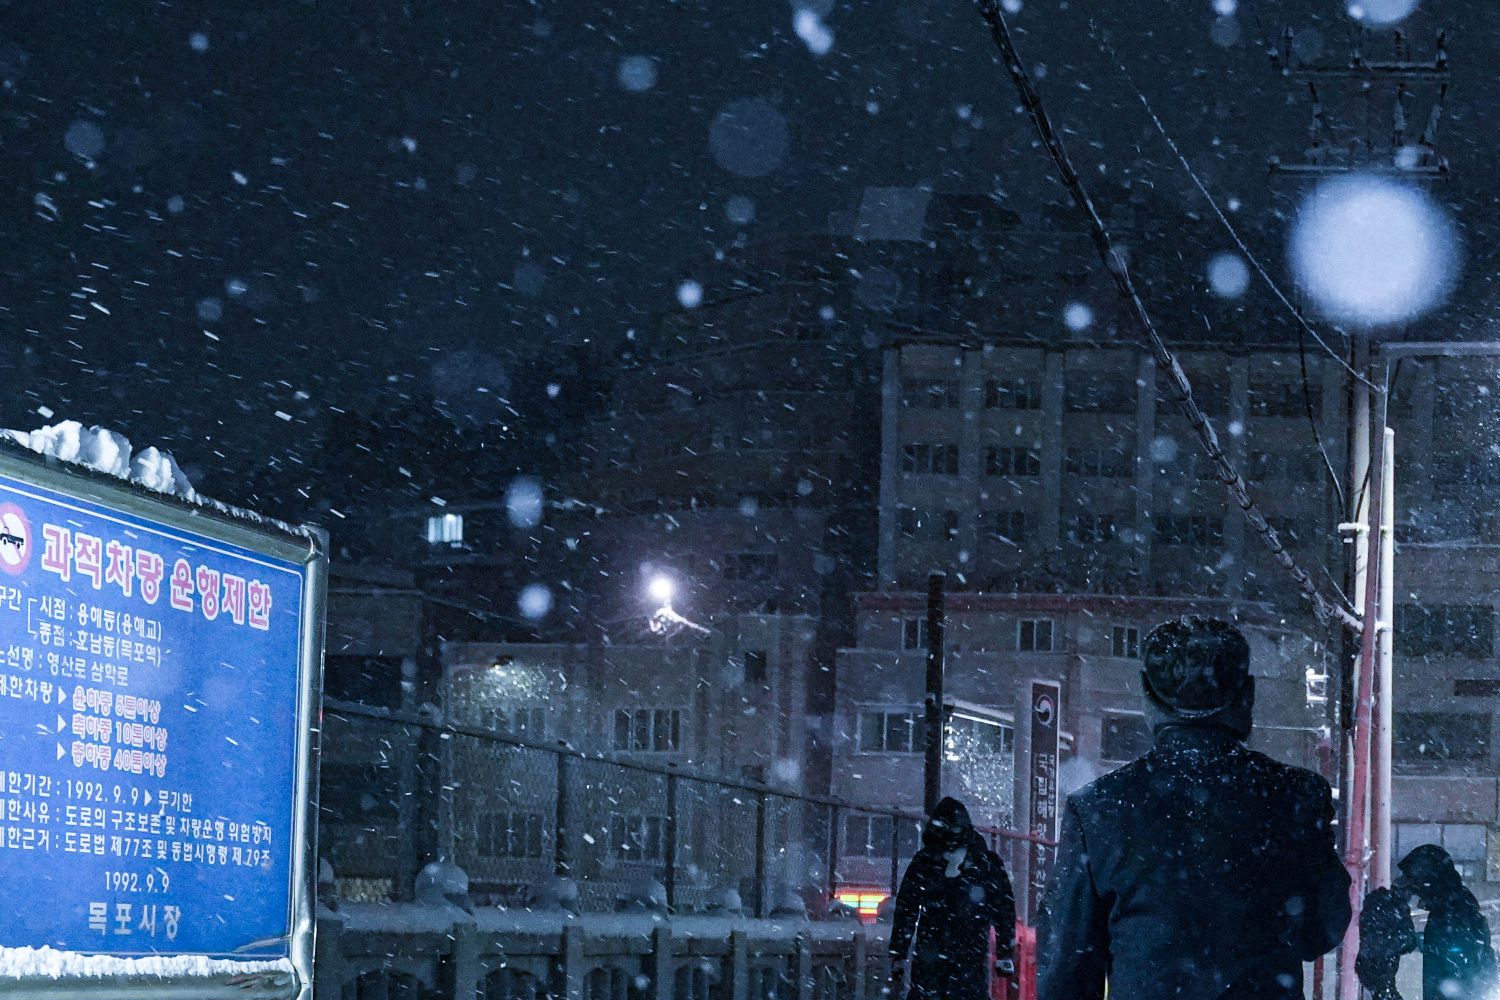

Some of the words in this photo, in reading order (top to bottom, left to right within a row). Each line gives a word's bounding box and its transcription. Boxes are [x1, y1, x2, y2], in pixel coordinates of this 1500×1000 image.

[42, 523, 163, 604] 과적차량
[170, 558, 272, 630] 운행제한
[40, 595, 66, 620] 시점
[40, 621, 65, 647] 종점
[47, 652, 86, 679] 영산로
[115, 721, 167, 752] 10톤이상
[114, 749, 167, 778] 40톤이상
[159, 790, 193, 813] 무기한
[65, 805, 106, 829] 도로의
[166, 815, 176, 835] 및
[229, 823, 272, 845] 위험방지
[65, 832, 105, 855] 도로법
[111, 835, 152, 858] 제77조
[157, 840, 167, 860] 및
